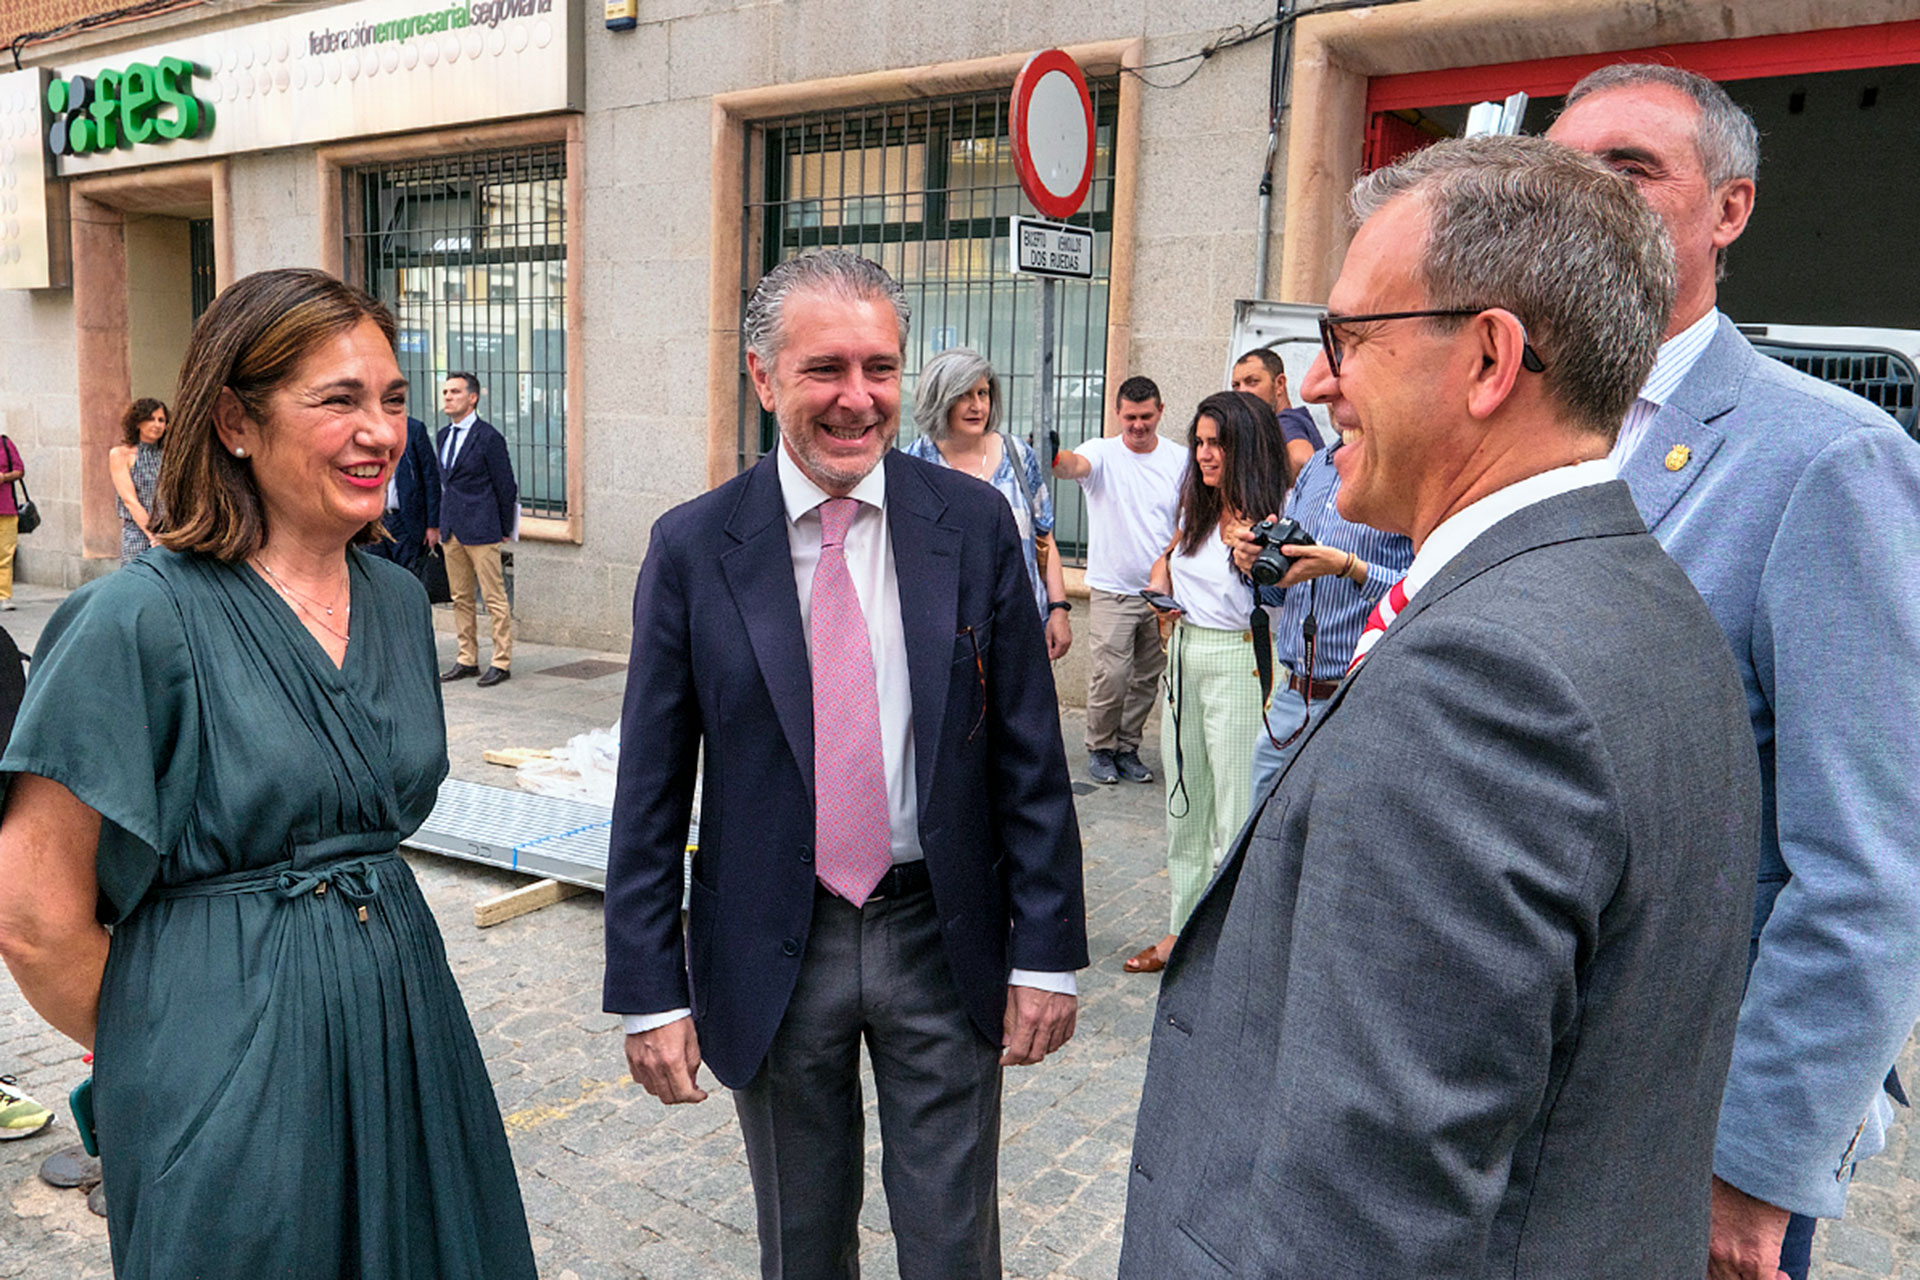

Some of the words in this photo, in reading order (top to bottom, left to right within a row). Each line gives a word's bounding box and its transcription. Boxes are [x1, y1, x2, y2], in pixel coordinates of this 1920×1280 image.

[90, 56, 198, 149] fes
[1030, 249, 1047, 267] DOS
[1049, 252, 1080, 271] RUEDAS
